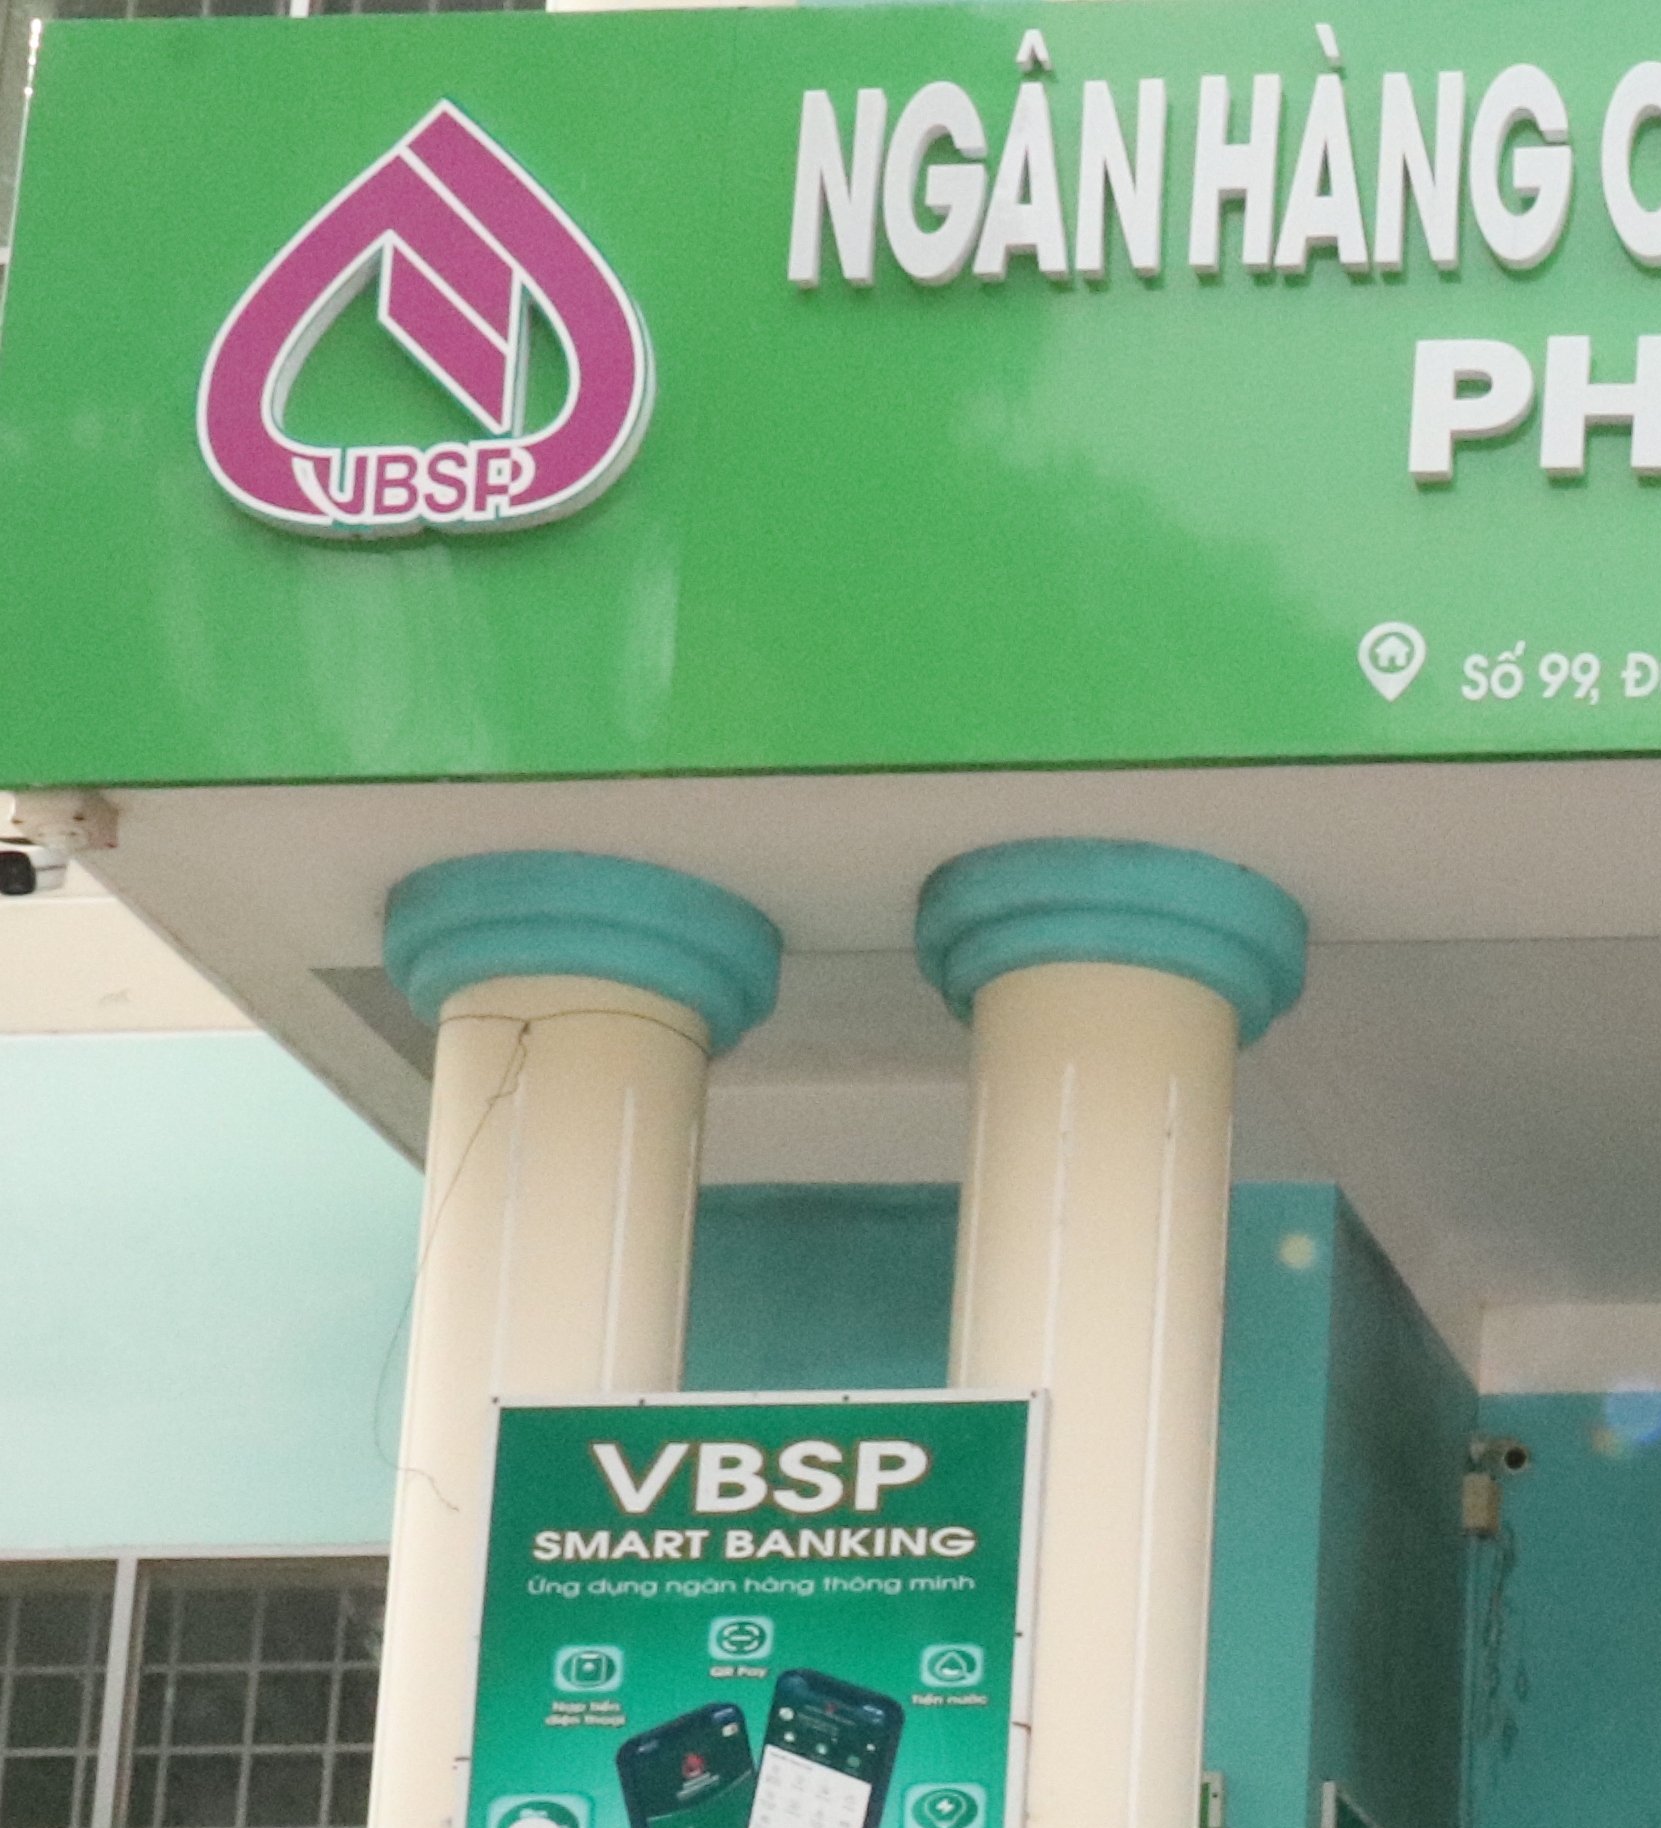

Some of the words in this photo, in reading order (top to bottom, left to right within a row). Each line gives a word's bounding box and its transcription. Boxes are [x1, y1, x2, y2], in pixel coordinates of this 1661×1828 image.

[788, 28, 1167, 287] NGÂN
[1189, 23, 1576, 277] HÀNG
[1462, 640, 1525, 701] Số
[1538, 652, 1601, 705] 99,
[592, 1440, 928, 1514] VBSP
[532, 1529, 710, 1561] SMART
[725, 1527, 977, 1560] BANKING
[588, 1576, 658, 1599] dụng
[909, 1575, 976, 1591] minh
